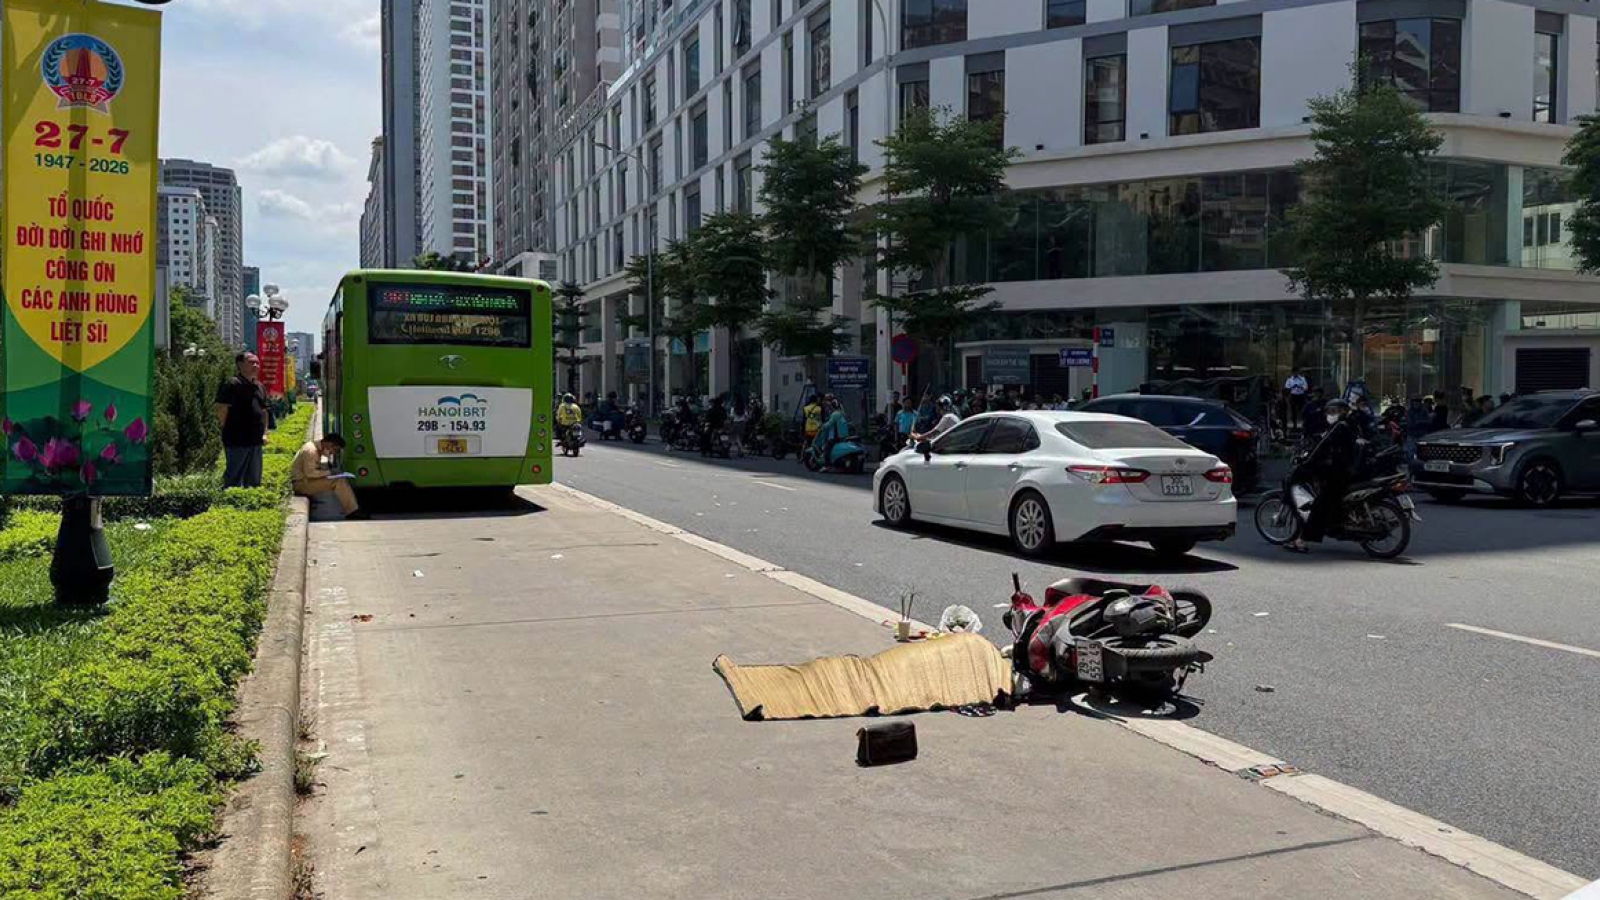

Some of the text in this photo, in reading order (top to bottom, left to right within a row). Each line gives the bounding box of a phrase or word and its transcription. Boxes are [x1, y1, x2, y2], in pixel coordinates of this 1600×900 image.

[34, 121, 130, 154] 27-7
[34, 153, 75, 169] 1947
[89, 158, 129, 174] 2026
[48, 190, 114, 222] TỔ QUỐC
[16, 222, 144, 254] ĐỜI ĐỜI GHI NHỚ
[46, 255, 115, 283] CÔNG ƠN
[21, 285, 138, 315] CÁC ANH HÙNG
[50, 317, 108, 346] LIỆT SĨ!
[417, 420, 439, 432] 29B
[450, 420, 486, 432] 154.93
[463, 406, 488, 418] BRT
